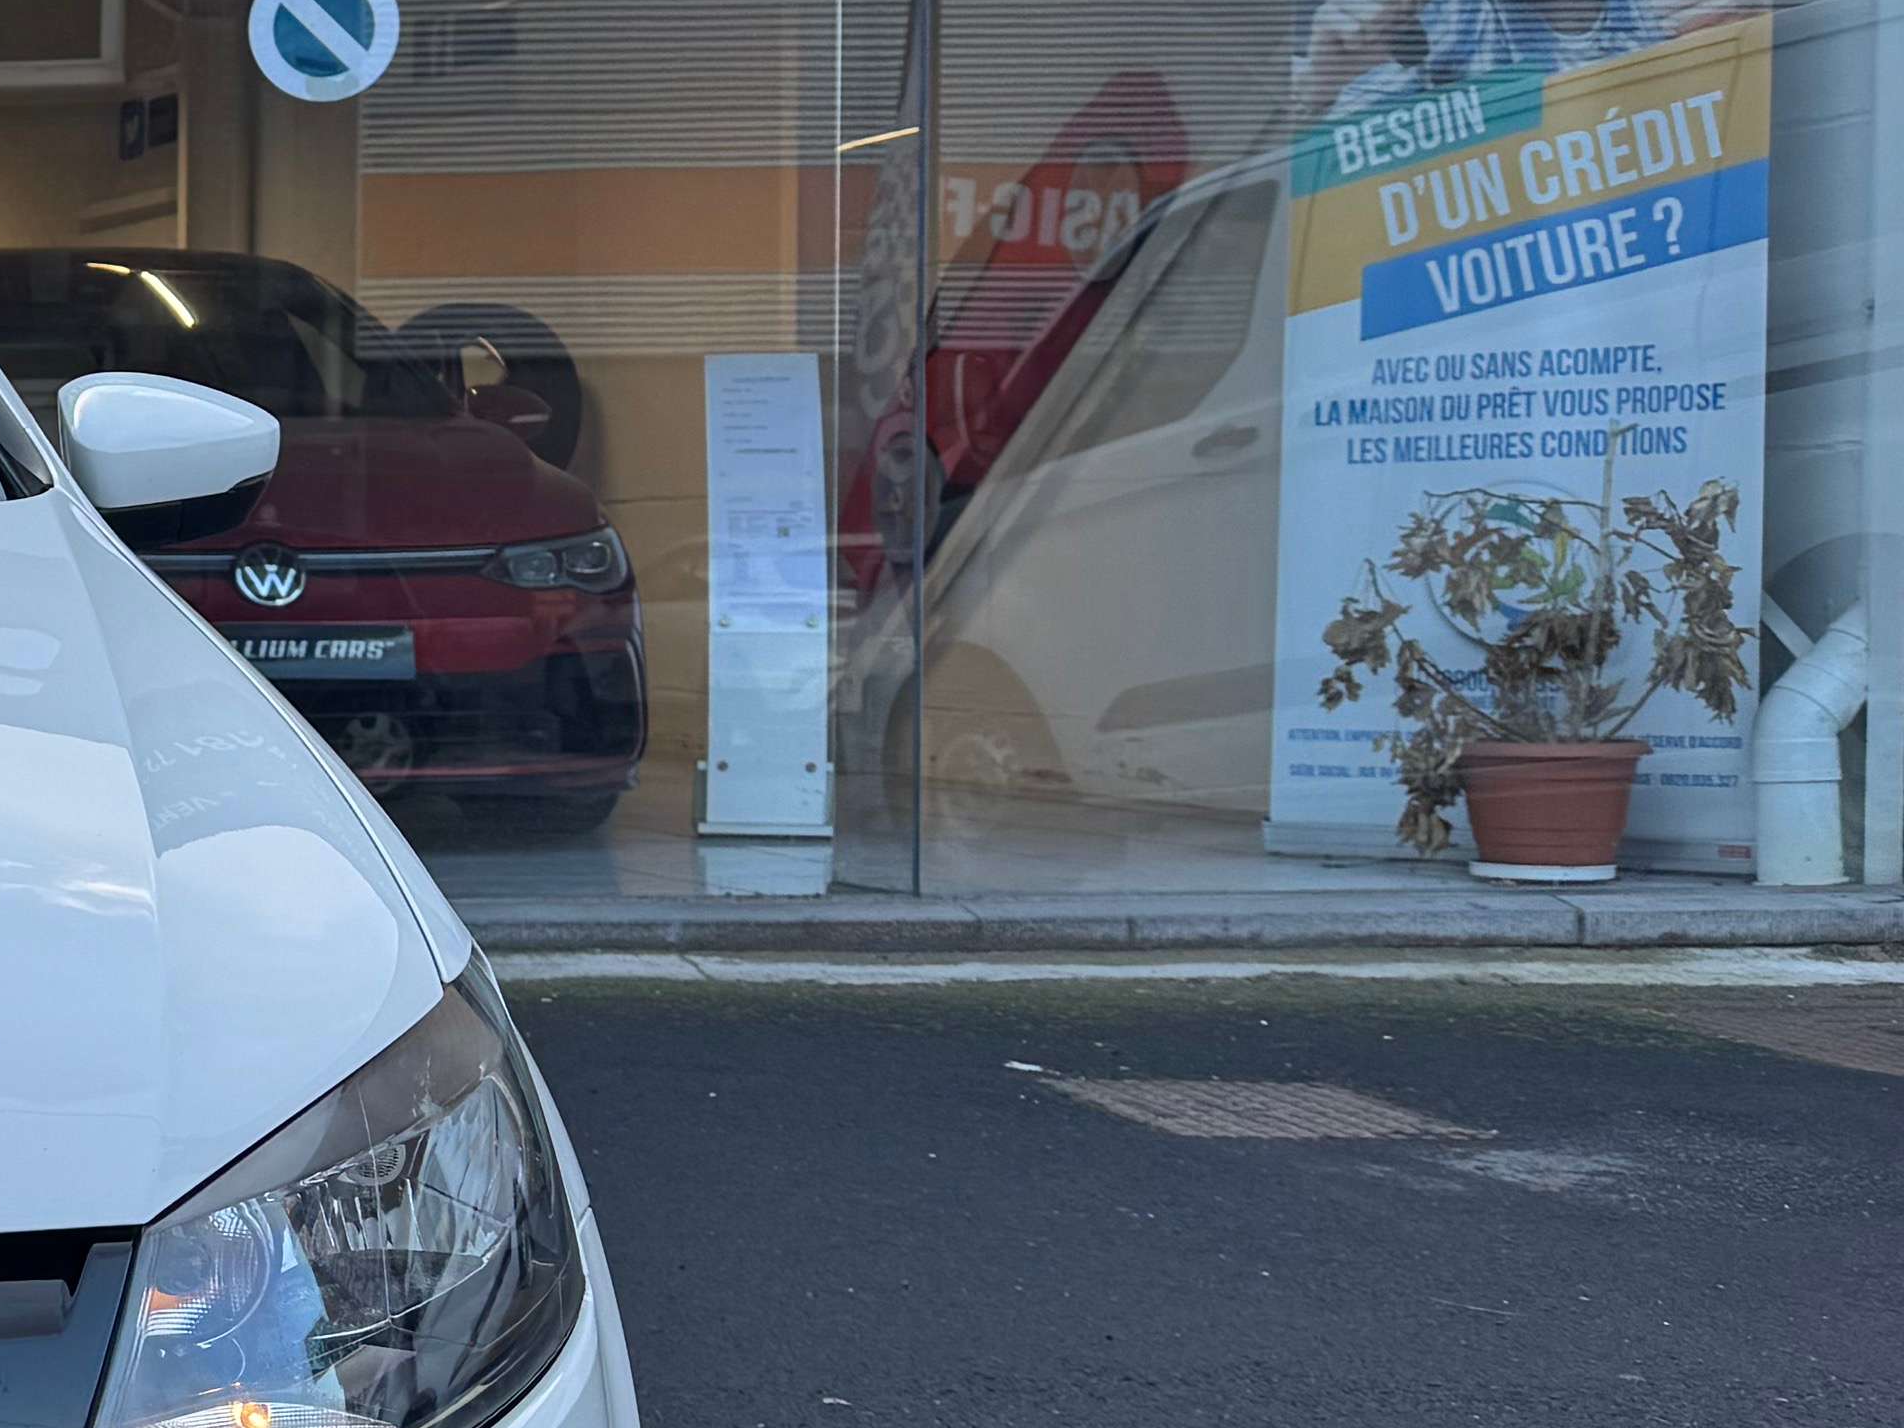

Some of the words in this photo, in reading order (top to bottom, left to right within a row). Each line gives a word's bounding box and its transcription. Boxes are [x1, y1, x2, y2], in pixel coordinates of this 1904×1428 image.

[1333, 85, 1486, 175] BESOIN
[1379, 153, 1511, 247] D'UN
[1519, 90, 1724, 205] CRÉDIT
[1425, 207, 1646, 314] VOITURE
[1652, 196, 1684, 256] ?
[1371, 356, 1429, 385] AVEC
[1435, 353, 1466, 382] OU
[1469, 350, 1533, 379] SANS
[1314, 400, 1341, 427] LA
[1347, 396, 1434, 426] MAISON
[1440, 394, 1470, 420] DU
[1477, 385, 1537, 419] PRÊT
[1542, 388, 1609, 416] VOUS
[1616, 382, 1727, 414] PROPOSE
[1347, 437, 1388, 465] LES
[1393, 431, 1533, 463] MEILLEURES
[1541, 425, 1688, 458] CONDTIONS
[314, 638, 385, 660] CARS
